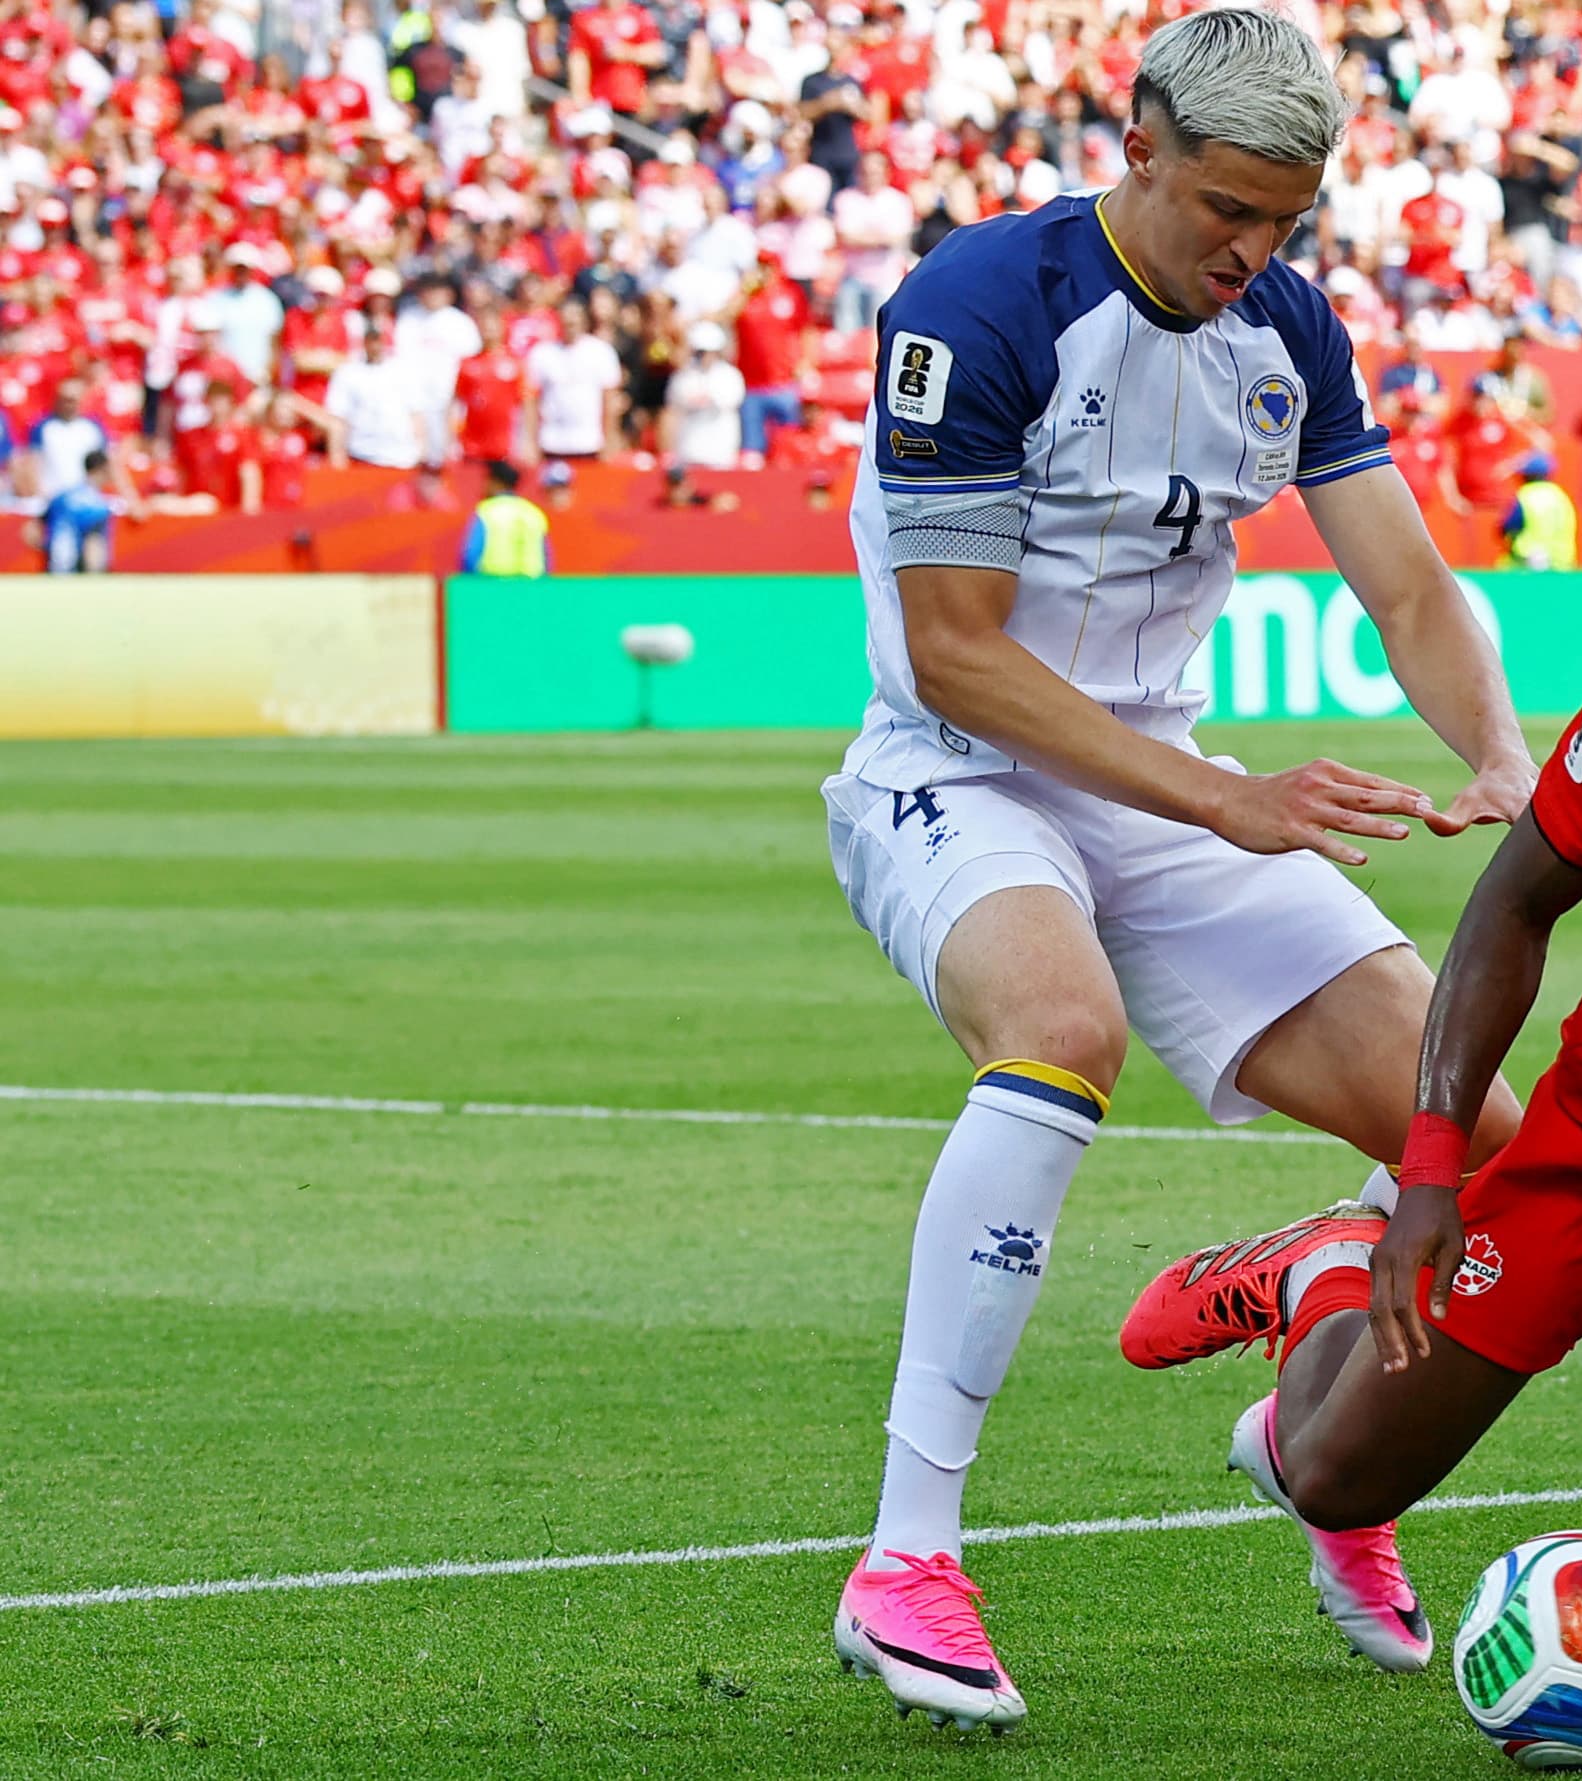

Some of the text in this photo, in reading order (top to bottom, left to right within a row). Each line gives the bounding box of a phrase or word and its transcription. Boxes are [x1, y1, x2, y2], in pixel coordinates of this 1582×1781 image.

[895, 402, 923, 415] 2026
[1153, 475, 1203, 556] 4
[893, 786, 945, 831] 4
[969, 1249, 1042, 1277] KELME
[1464, 1260, 1497, 1281] NADA
